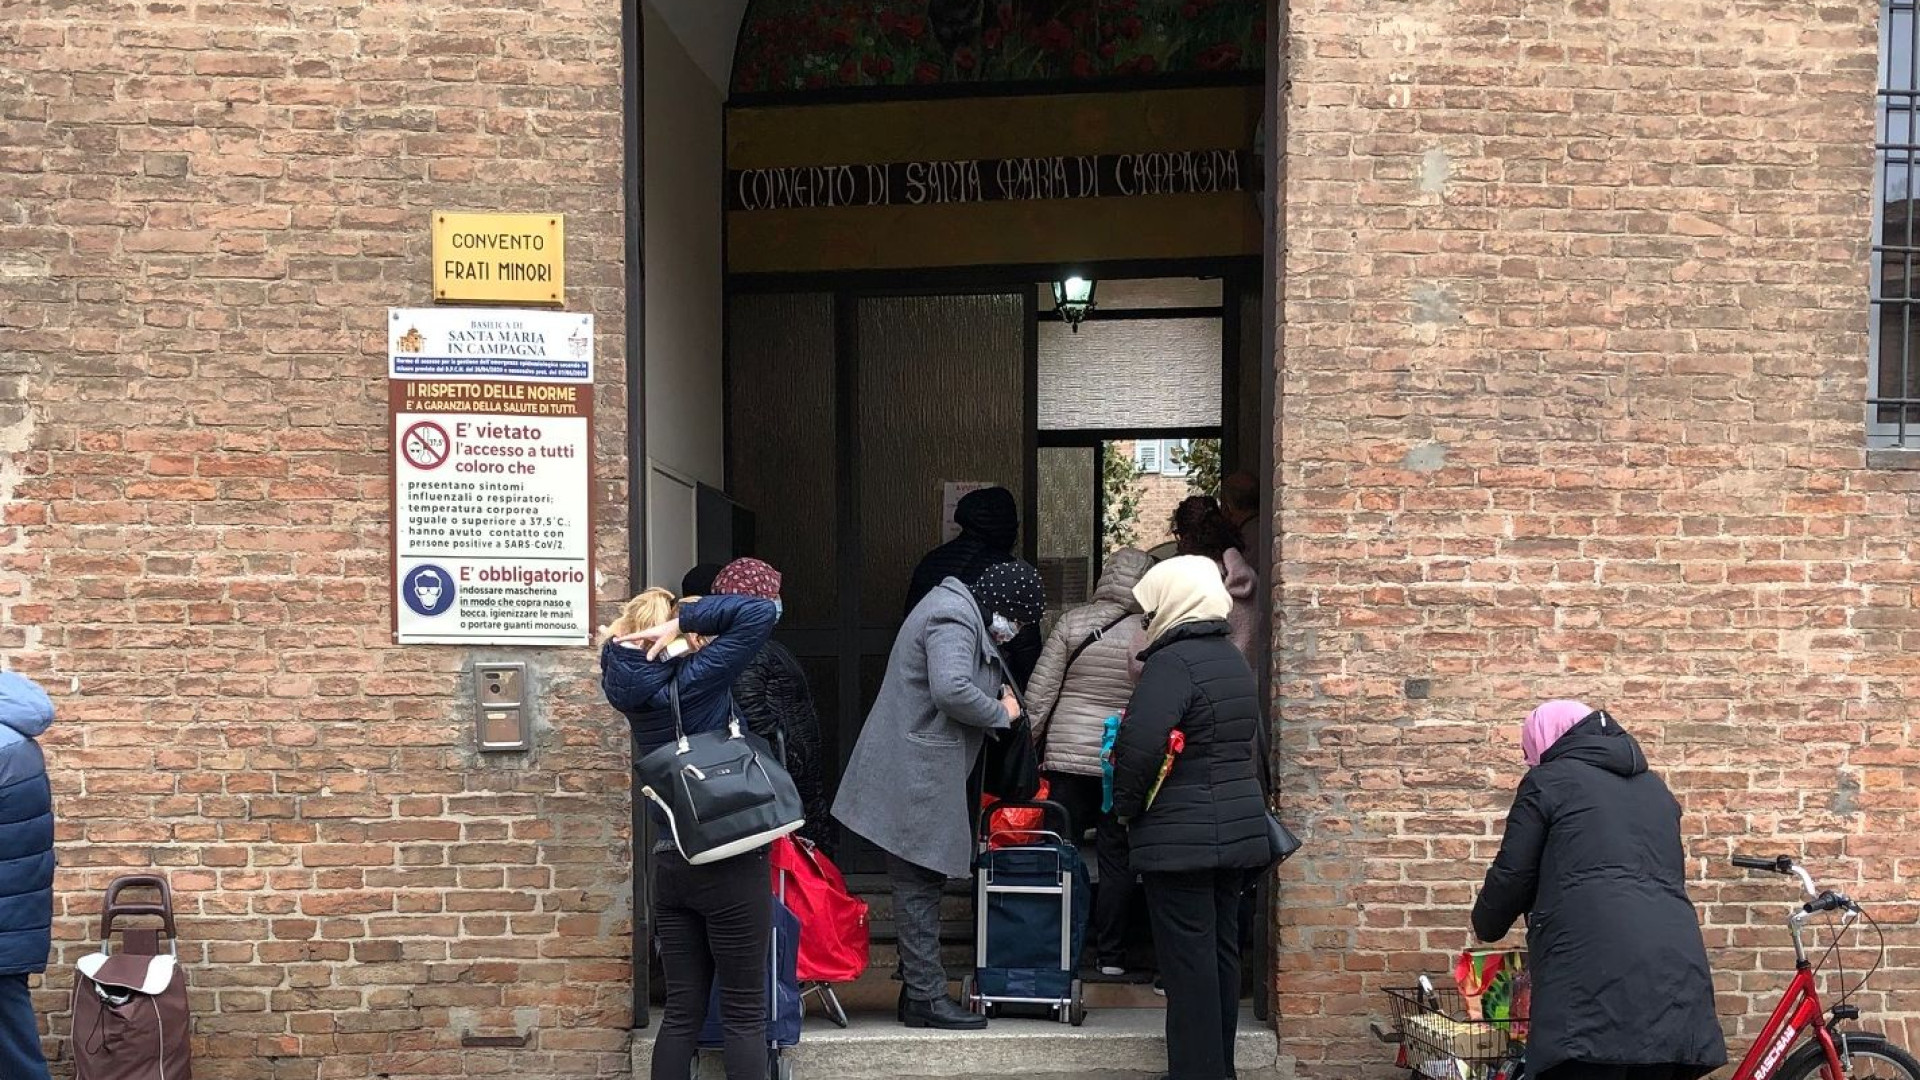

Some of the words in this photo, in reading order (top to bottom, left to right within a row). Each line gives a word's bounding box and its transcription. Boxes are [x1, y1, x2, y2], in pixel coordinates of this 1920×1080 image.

[739, 166, 855, 210] CONVENTO
[867, 164, 889, 205] DI
[906, 160, 983, 204] SANTA
[997, 157, 1069, 200] MARIA
[1078, 155, 1099, 198] DI
[1116, 150, 1242, 196] CAMPAGNA
[452, 233, 543, 250] CONVENTO
[446, 261, 489, 280] FRATI
[499, 263, 551, 282] MINORI
[471, 321, 512, 329] BASILICA
[449, 331, 493, 342] SANTA
[498, 332, 545, 343] MARIA
[448, 343, 463, 353] IN
[467, 344, 546, 356] CAMPAGNA
[419, 384, 480, 398] RISPETTO
[484, 385, 524, 399] DELLE
[528, 386, 576, 401] NORME
[416, 401, 423, 410] A
[424, 401, 470, 411] GARANZIA
[473, 402, 501, 412] DELLA
[504, 403, 538, 413] SALUTE
[540, 404, 548, 413] DI
[457, 422, 471, 438] E'
[477, 422, 541, 440] vietato
[457, 442, 523, 457] l'accesso
[528, 446, 536, 457] a
[541, 444, 574, 458] tutti
[455, 461, 504, 473] coloro
[508, 462, 535, 474] che
[408, 481, 475, 491] presentano
[480, 482, 524, 491] sintomi
[408, 492, 472, 502] influenzali
[409, 505, 482, 515] temperatura
[487, 507, 538, 515] corporea
[409, 516, 446, 525] uguale
[462, 517, 515, 526] superiore
[409, 527, 444, 536] hanno
[490, 529, 540, 537] contatto
[409, 539, 449, 548] persone
[453, 540, 493, 548] positive
[460, 567, 474, 581] E'
[480, 567, 584, 585] obbligatorio
[460, 586, 503, 595] indossare
[505, 587, 557, 596] mascherina
[460, 597, 468, 605] in
[470, 597, 496, 606] modo
[498, 598, 514, 606] che
[516, 599, 540, 608] copra
[490, 610, 537, 620] igienizzare
[540, 610, 547, 618] le
[550, 611, 573, 619] mani
[468, 620, 501, 629] portare
[504, 621, 532, 630] guanti
[535, 622, 578, 630] monouso.
